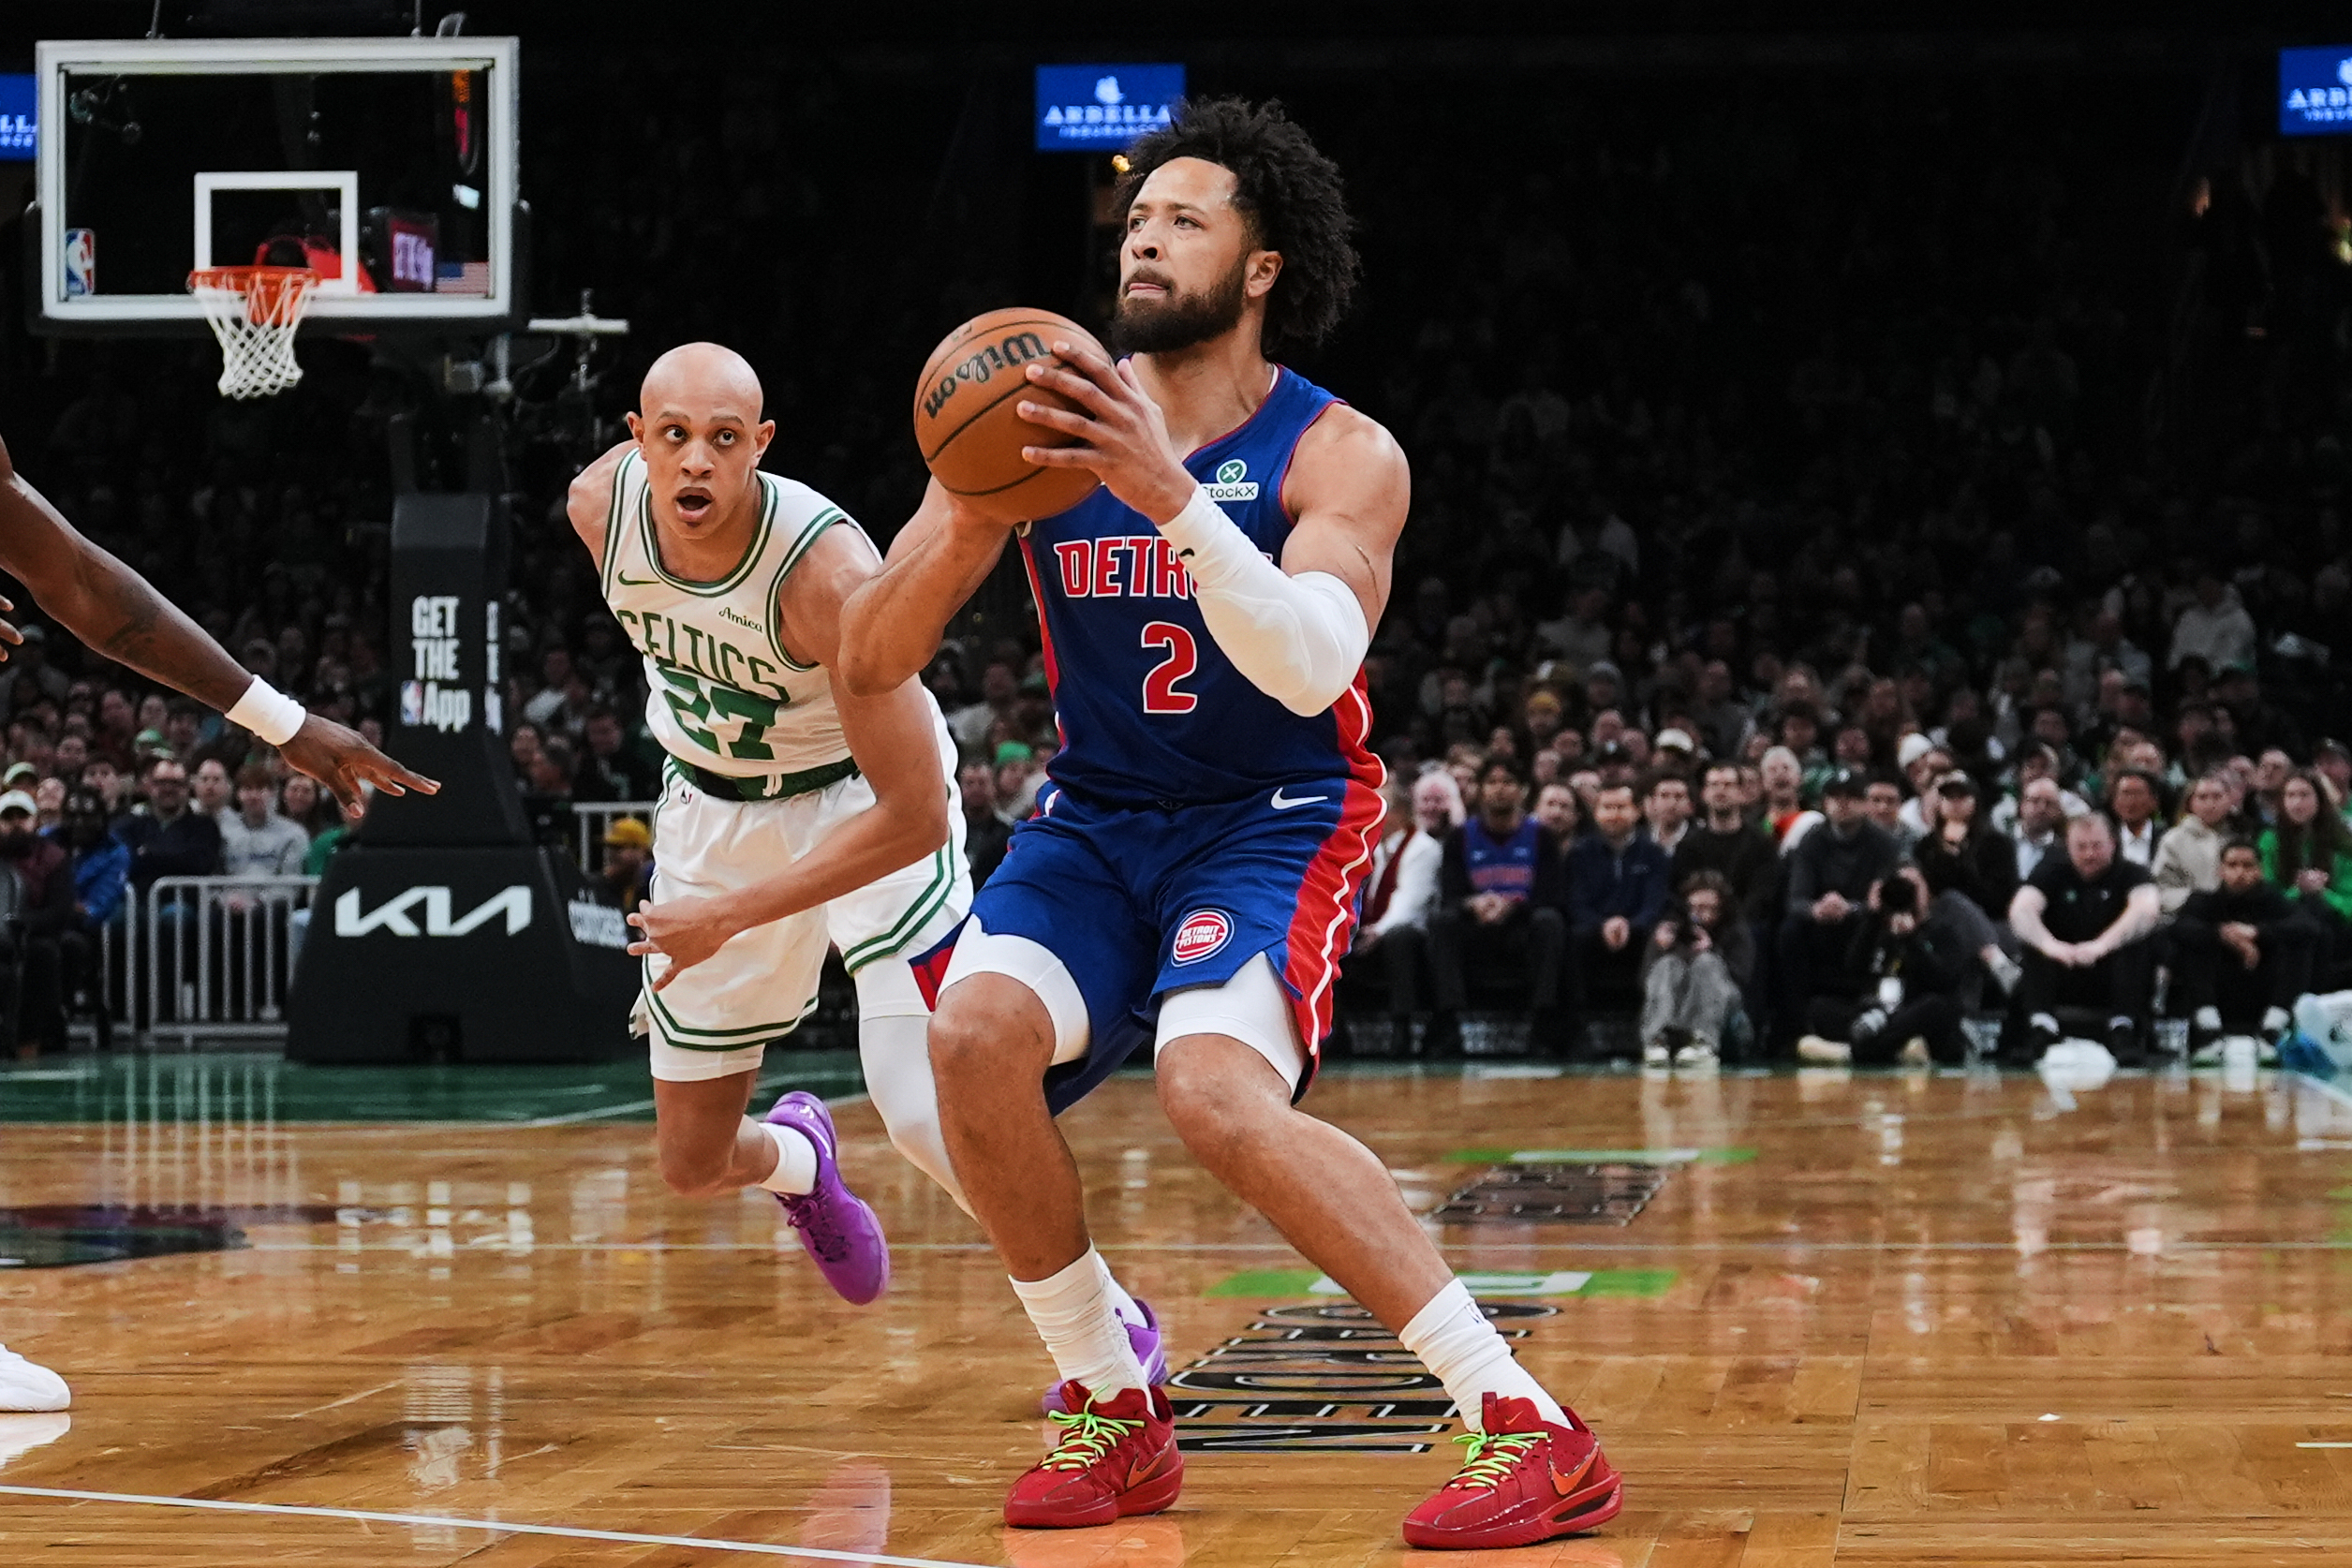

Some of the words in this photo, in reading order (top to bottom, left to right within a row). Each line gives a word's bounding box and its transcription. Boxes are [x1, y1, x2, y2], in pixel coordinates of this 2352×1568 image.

[924, 331, 1051, 420] Wilson
[1054, 536, 1273, 601] DETR
[411, 596, 460, 637] GET
[718, 606, 763, 633] Amica
[411, 638, 460, 680] THE
[616, 609, 791, 703] CELTICS
[1141, 620, 1198, 714] 2
[422, 681, 471, 732] App
[656, 666, 780, 761] 27
[334, 885, 532, 937] KIA
[1181, 925, 1220, 937] DETROIT
[1178, 936, 1216, 949] PISTONS
